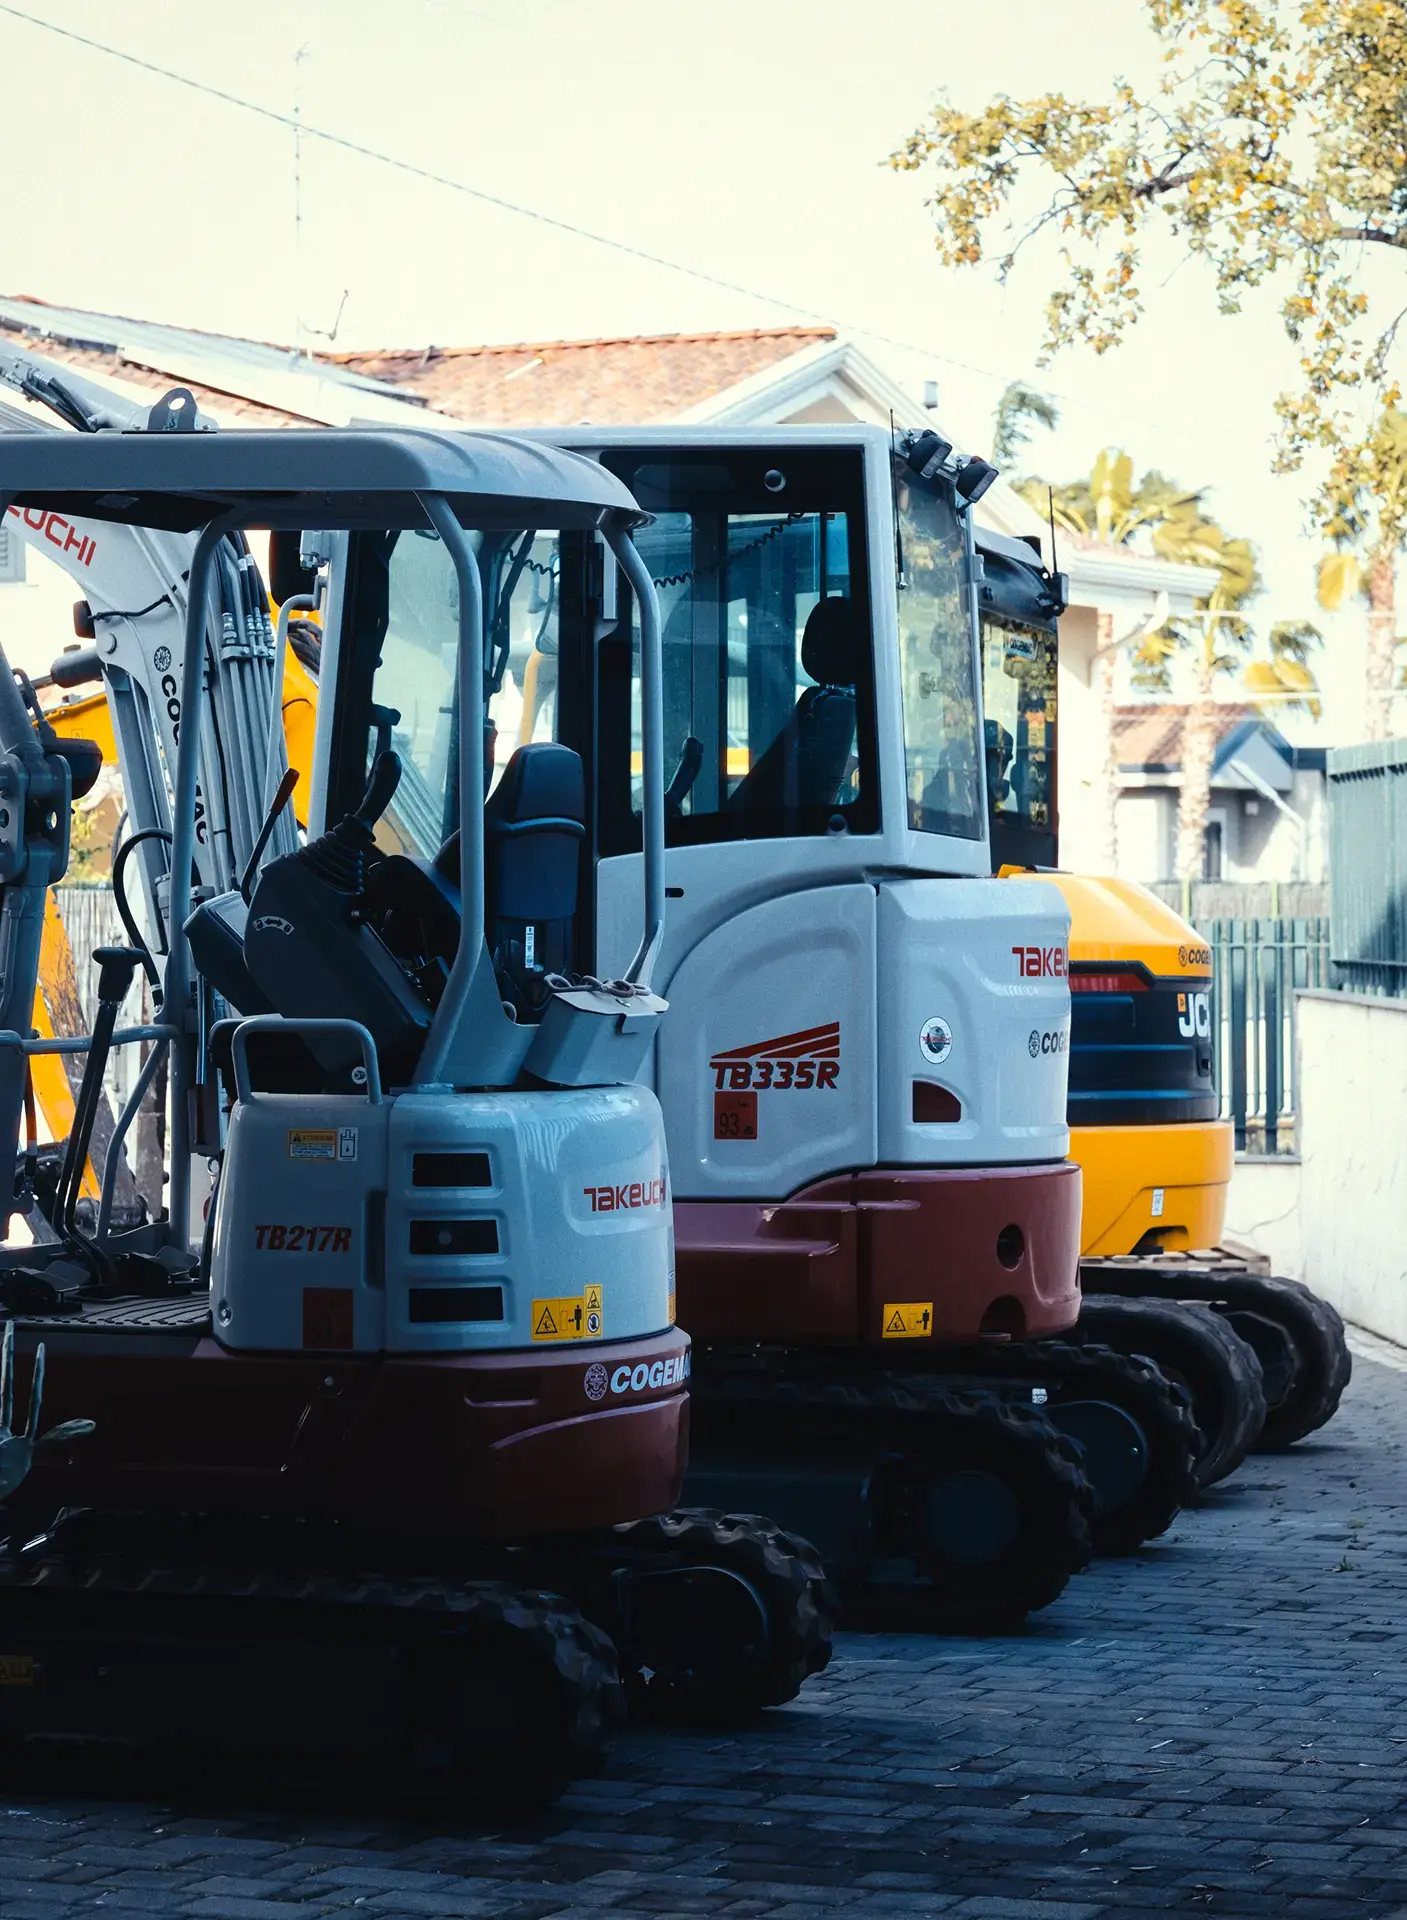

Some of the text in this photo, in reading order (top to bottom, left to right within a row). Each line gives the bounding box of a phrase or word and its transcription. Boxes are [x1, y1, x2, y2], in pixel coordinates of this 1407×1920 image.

[8, 505, 96, 567] UCHI
[1188, 949, 1212, 964] COGE
[1178, 993, 1211, 1037] JC
[1042, 1031, 1067, 1054] COG
[709, 1061, 840, 1089] TB335R
[719, 1113, 739, 1135] 93
[255, 1225, 352, 1252] TB217R
